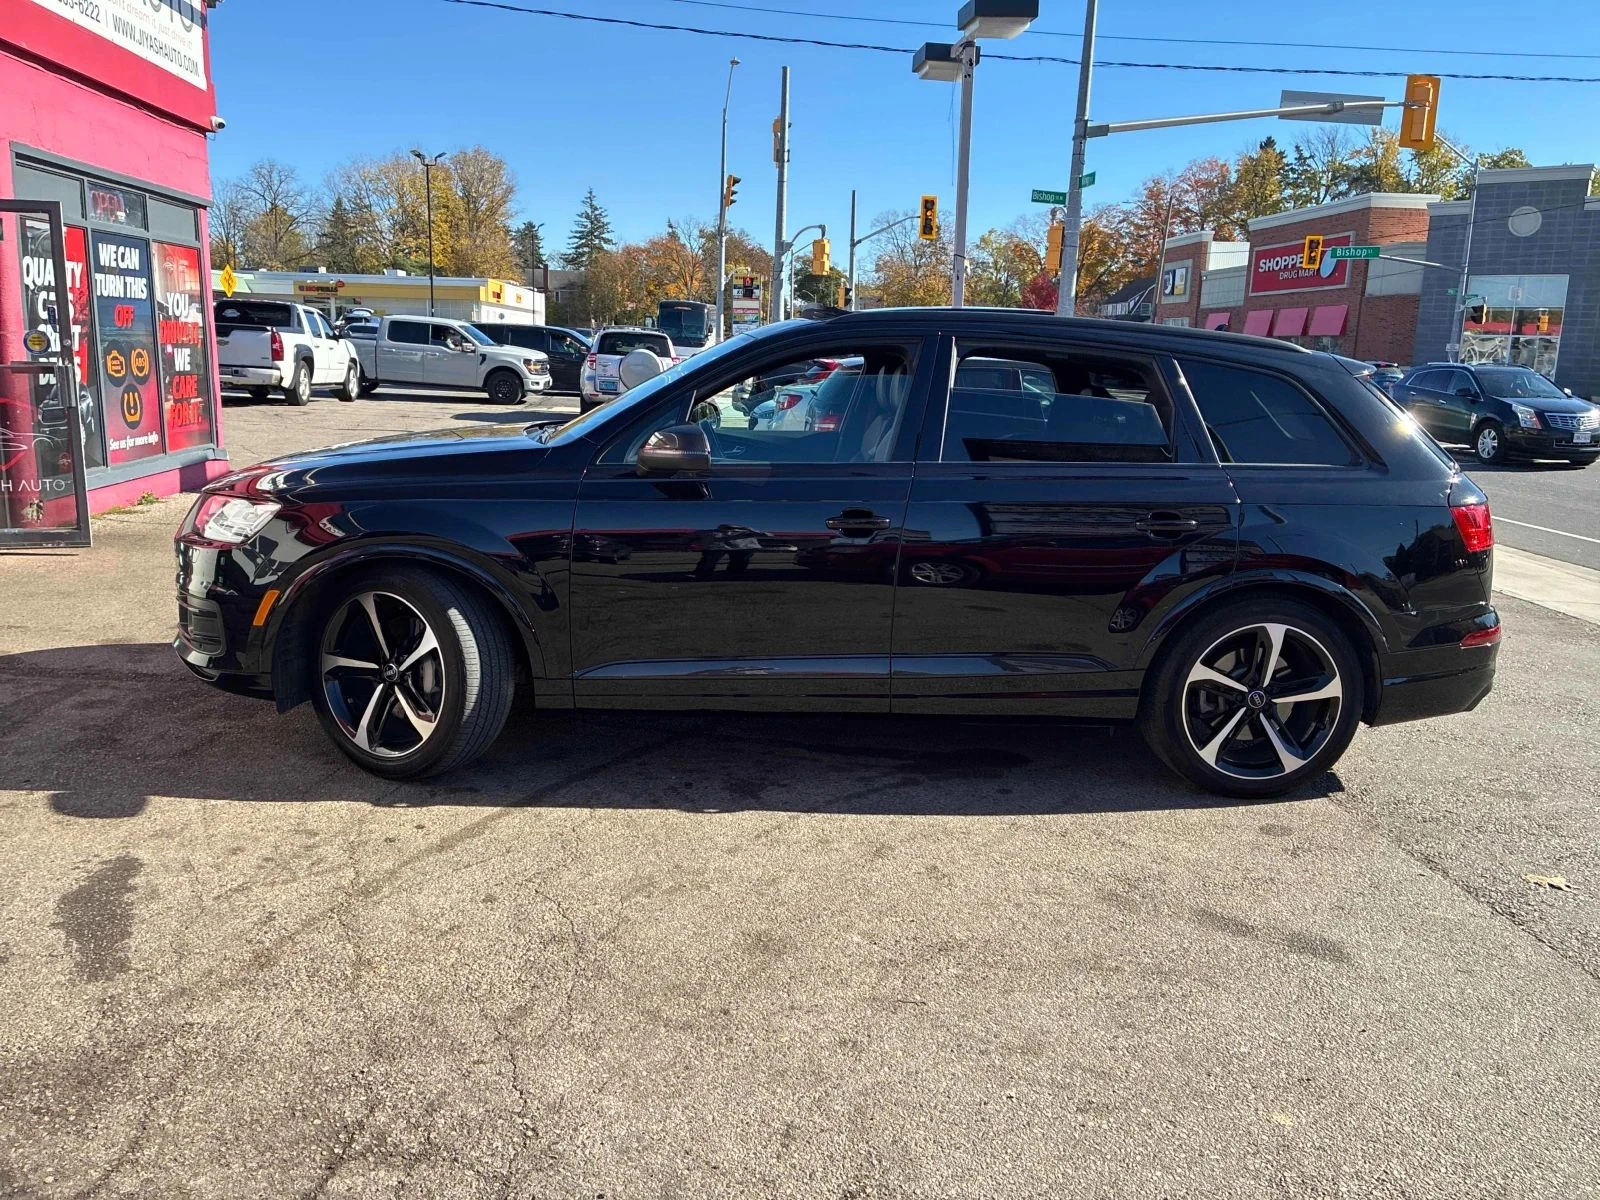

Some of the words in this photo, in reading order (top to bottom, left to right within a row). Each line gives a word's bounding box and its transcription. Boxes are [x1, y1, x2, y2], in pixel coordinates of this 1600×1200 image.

[112, 13, 200, 77] WWW.JIYASHAUTO.COM
[1032, 191, 1055, 202] Bishop
[98, 243, 117, 268] WE
[118, 245, 140, 271] CAN
[1336, 248, 1367, 258] Bishop
[95, 272, 124, 297] TURN
[125, 276, 148, 300] THIS
[1280, 271, 1298, 280] DRUG
[1299, 269, 1317, 278] MART
[114, 304, 134, 328] OFF
[166, 291, 189, 318] YOU
[173, 347, 191, 371] WE
[172, 374, 197, 399] CARE
[169, 403, 189, 427] FOR
[110, 438, 120, 450] See
[120, 440, 127, 449] us
[126, 435, 135, 450] for
[135, 436, 148, 446] more
[148, 431, 158, 445] info
[18, 479, 65, 491] AUTO
